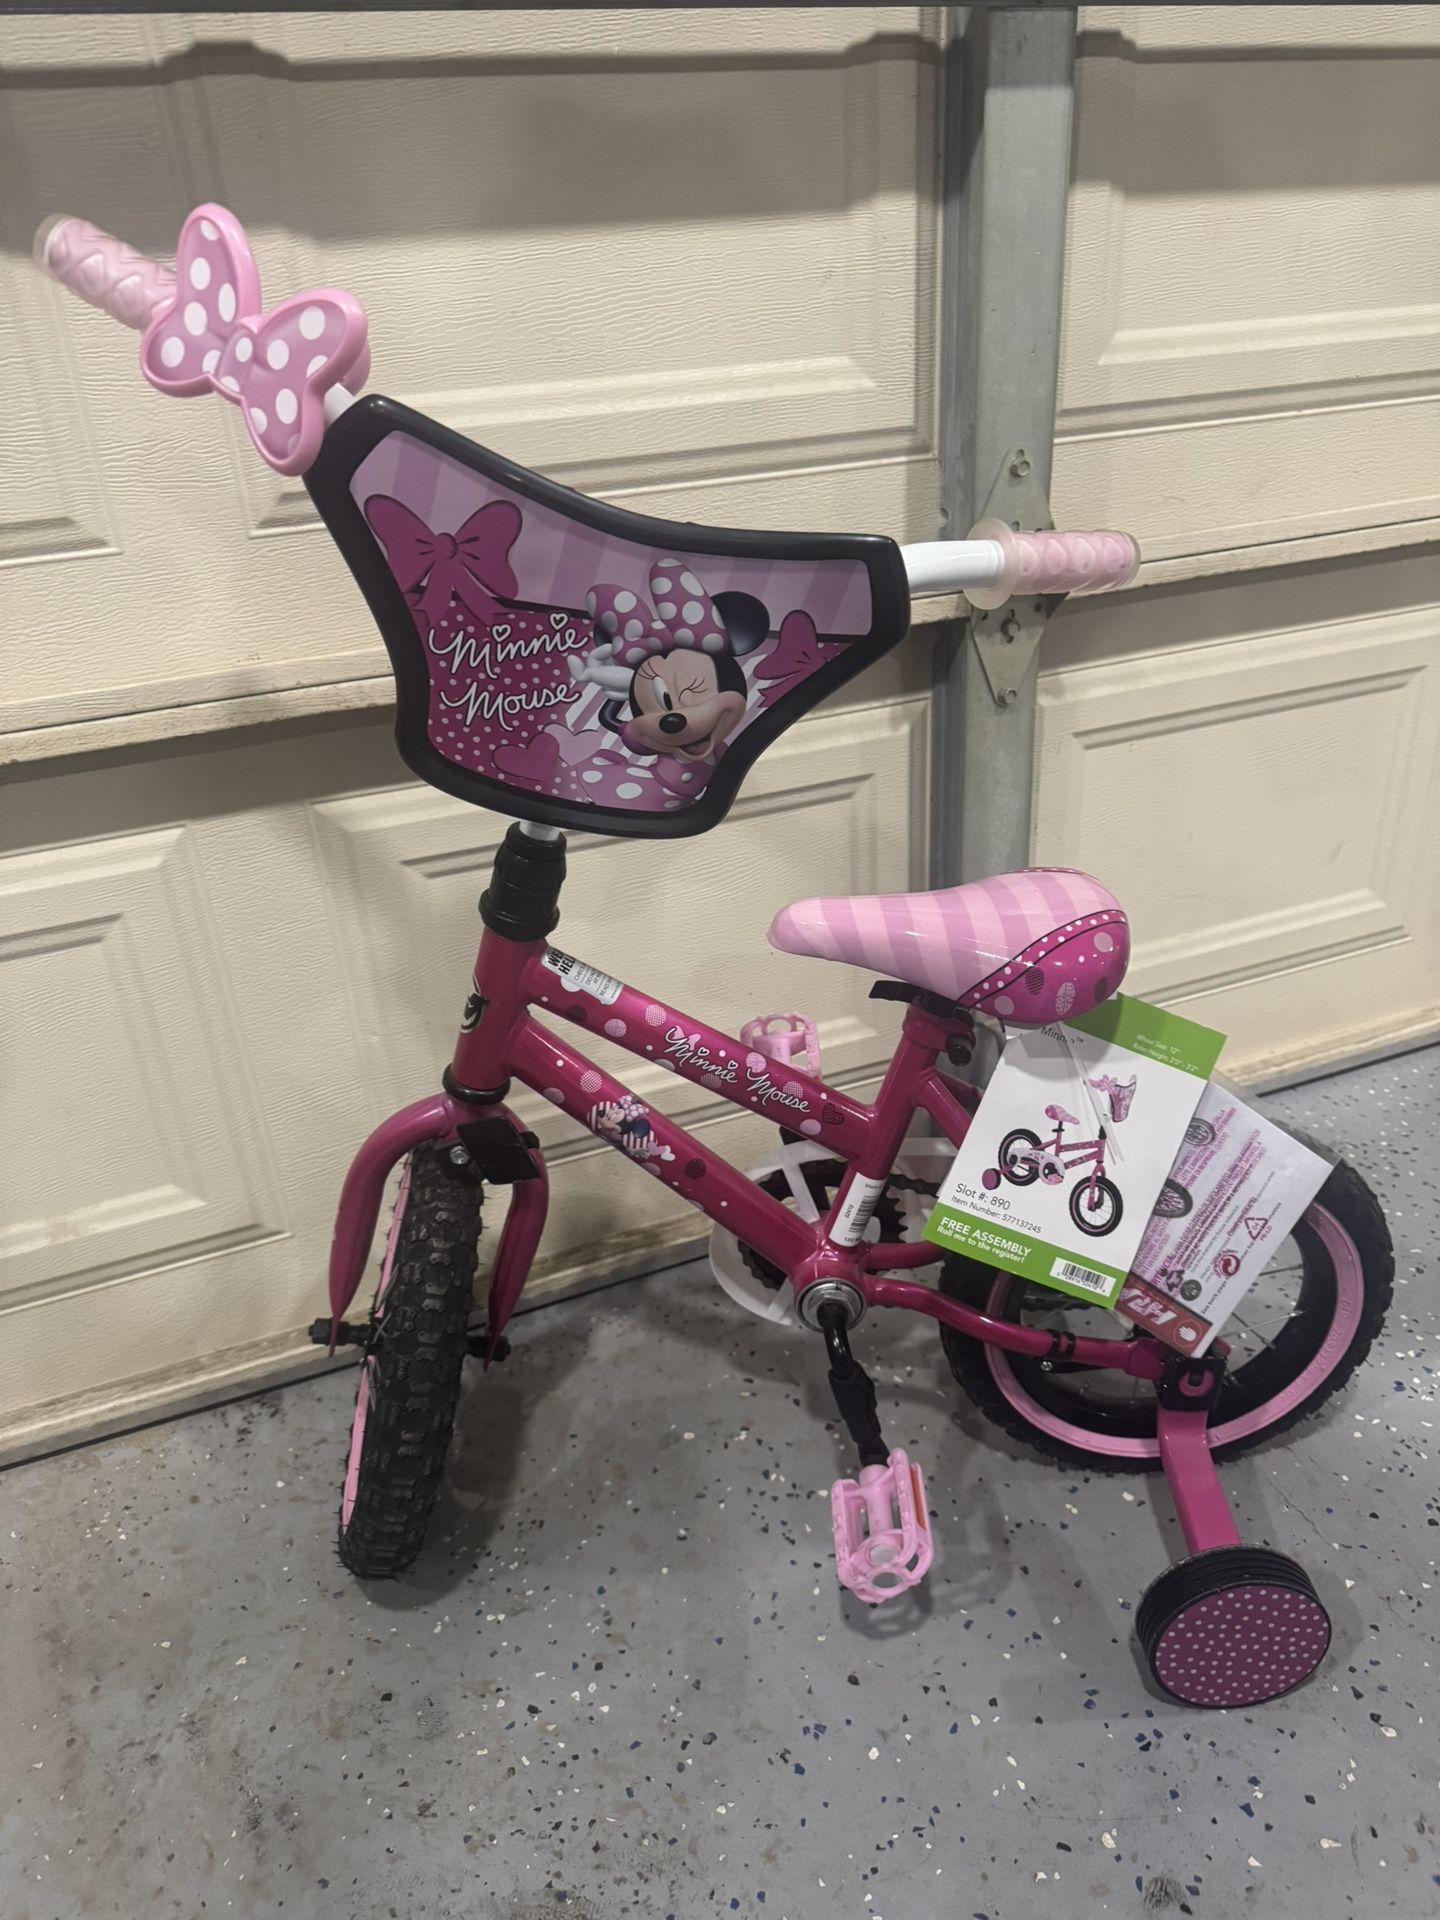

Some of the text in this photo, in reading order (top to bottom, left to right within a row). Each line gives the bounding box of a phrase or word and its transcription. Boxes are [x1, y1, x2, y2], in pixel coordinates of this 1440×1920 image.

[428, 613, 588, 679] Minnie
[440, 682, 580, 731] Mouse
[547, 950, 564, 967] WE
[558, 955, 576, 975] HEL
[664, 1027, 810, 1113] Minnie Mouse
[952, 1195, 1042, 1234] Item Number: 577137245
[956, 1183, 1011, 1210] Slot #: 890
[937, 1226, 1026, 1264] Roll me to the register!
[940, 1216, 1032, 1257] FREE ASSEMBLY
